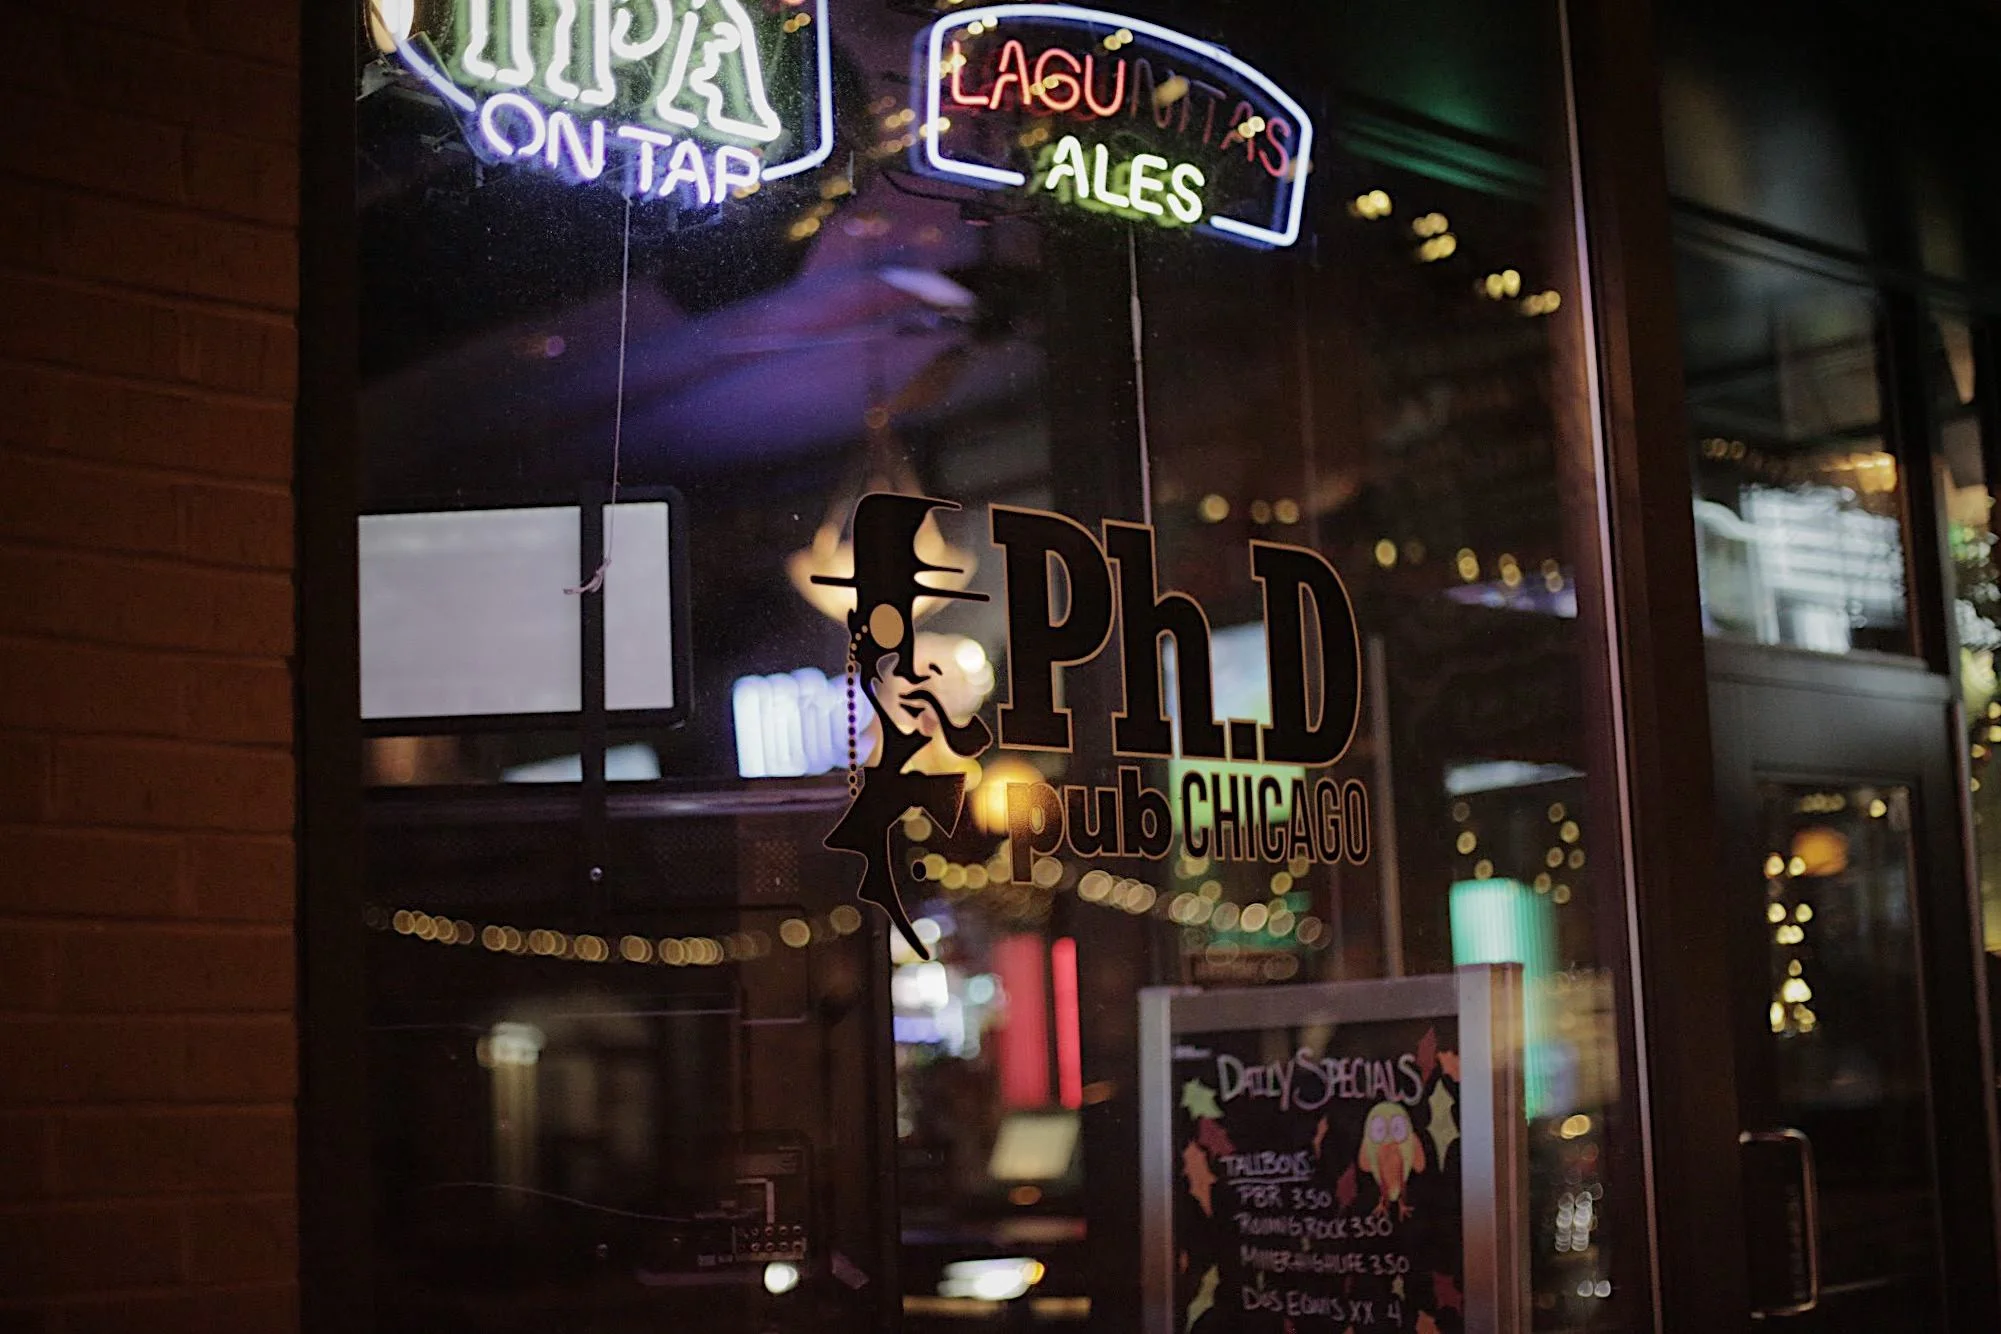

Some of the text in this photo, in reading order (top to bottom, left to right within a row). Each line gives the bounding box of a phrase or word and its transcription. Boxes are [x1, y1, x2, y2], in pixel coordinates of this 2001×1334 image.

[479, 92, 763, 206] ON TAP
[951, 39, 1292, 179] LAGUNITAS
[1045, 134, 1207, 225] ALES
[988, 502, 1363, 768] Ph.D
[1006, 764, 1371, 886] pub CHICAGO
[1217, 1046, 1424, 1111] DAILY SPECIALS
[1236, 1184, 1284, 1209] PBR
[1349, 1300, 1375, 1325] XX
[1387, 1298, 1403, 1328] 4
